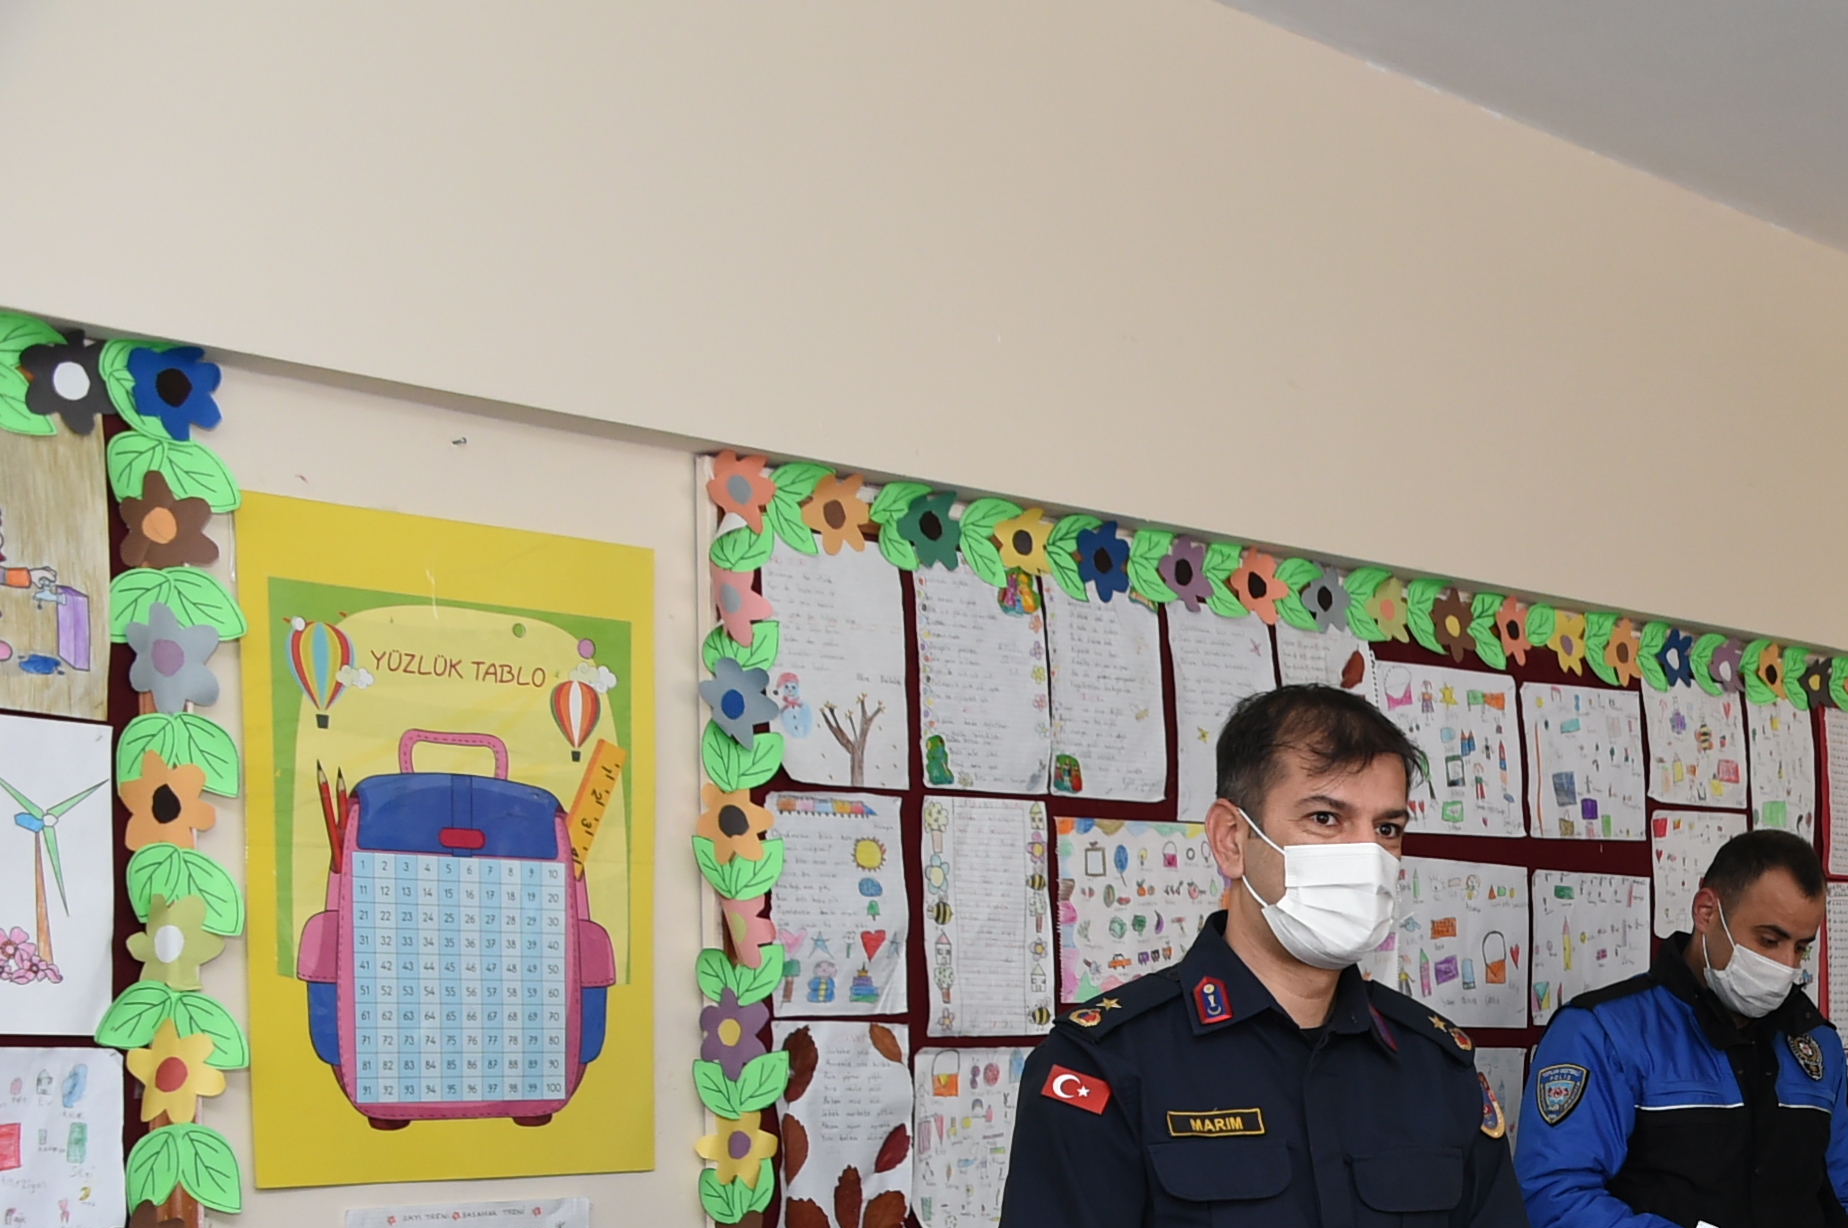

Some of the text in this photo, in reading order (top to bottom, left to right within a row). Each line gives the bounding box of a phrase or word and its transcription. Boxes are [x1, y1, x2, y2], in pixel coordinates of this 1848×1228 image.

[370, 649, 546, 688] YÜZLÜK TABLO
[547, 868, 559, 880] 10
[359, 884, 560, 904] 11 12 13 14 15 16 17 18 19 20
[358, 909, 560, 928] 21 22 23 24 25 26 27 28 29 30
[358, 934, 560, 951] 31 32 33 34 35 36 37 38 39 40
[359, 960, 560, 975] 41 42 43 44 45 46 47 48 49 50
[359, 984, 560, 999] 51 52 53 54 55 56 57 58 59 60
[360, 1010, 560, 1022] 61 62 63 64 65 66 67 68 69 70
[361, 1034, 560, 1046] 71 72 73 74 75 76 77 78 79 80
[361, 1058, 560, 1071] 81 82 83 84 85 86 87 88 89 90
[362, 1082, 562, 1096] 91 92 93 94 95 96 97 98 99 100
[1189, 1116, 1244, 1132] MARIM
